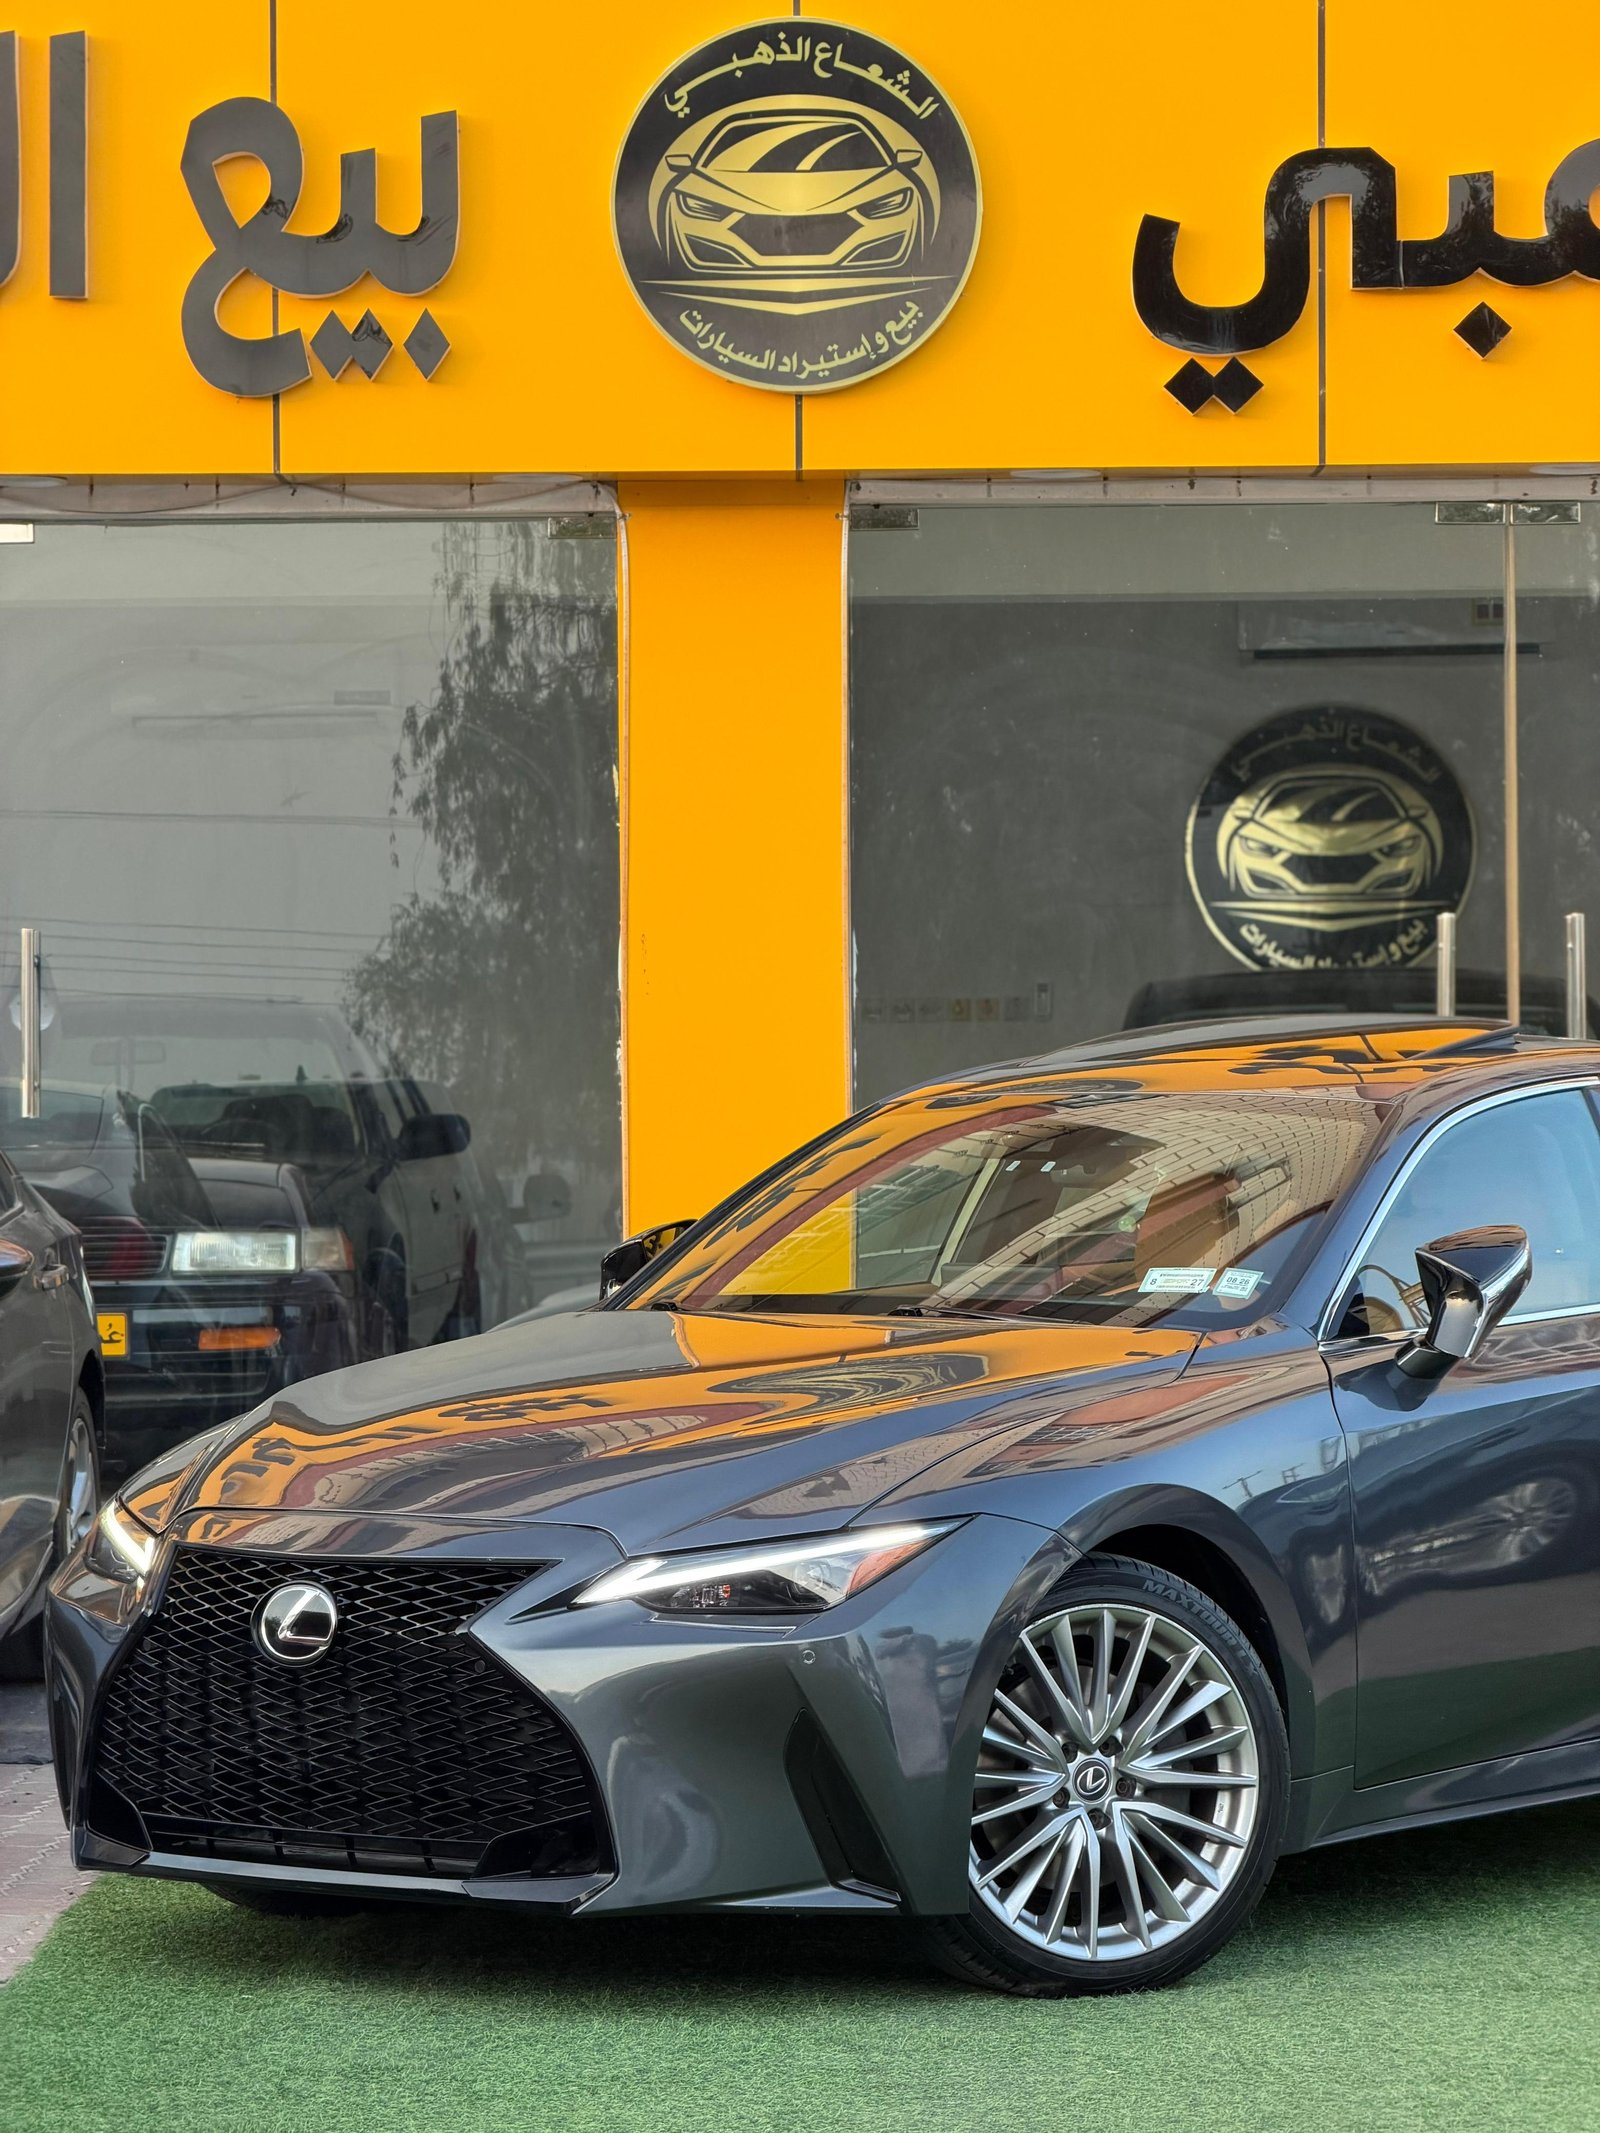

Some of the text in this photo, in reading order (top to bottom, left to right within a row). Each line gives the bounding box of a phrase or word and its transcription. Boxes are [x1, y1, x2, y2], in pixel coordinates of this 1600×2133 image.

[664, 31, 940, 120] الشعاع الذهبي
[180, 97, 460, 399] بيع
[679, 308, 776, 373] السيارات
[885, 300, 924, 344] بيع
[1150, 1278, 1157, 1286] 8
[1190, 1278, 1204, 1286] 27
[1142, 1579, 1238, 1648] MAXTOUR
